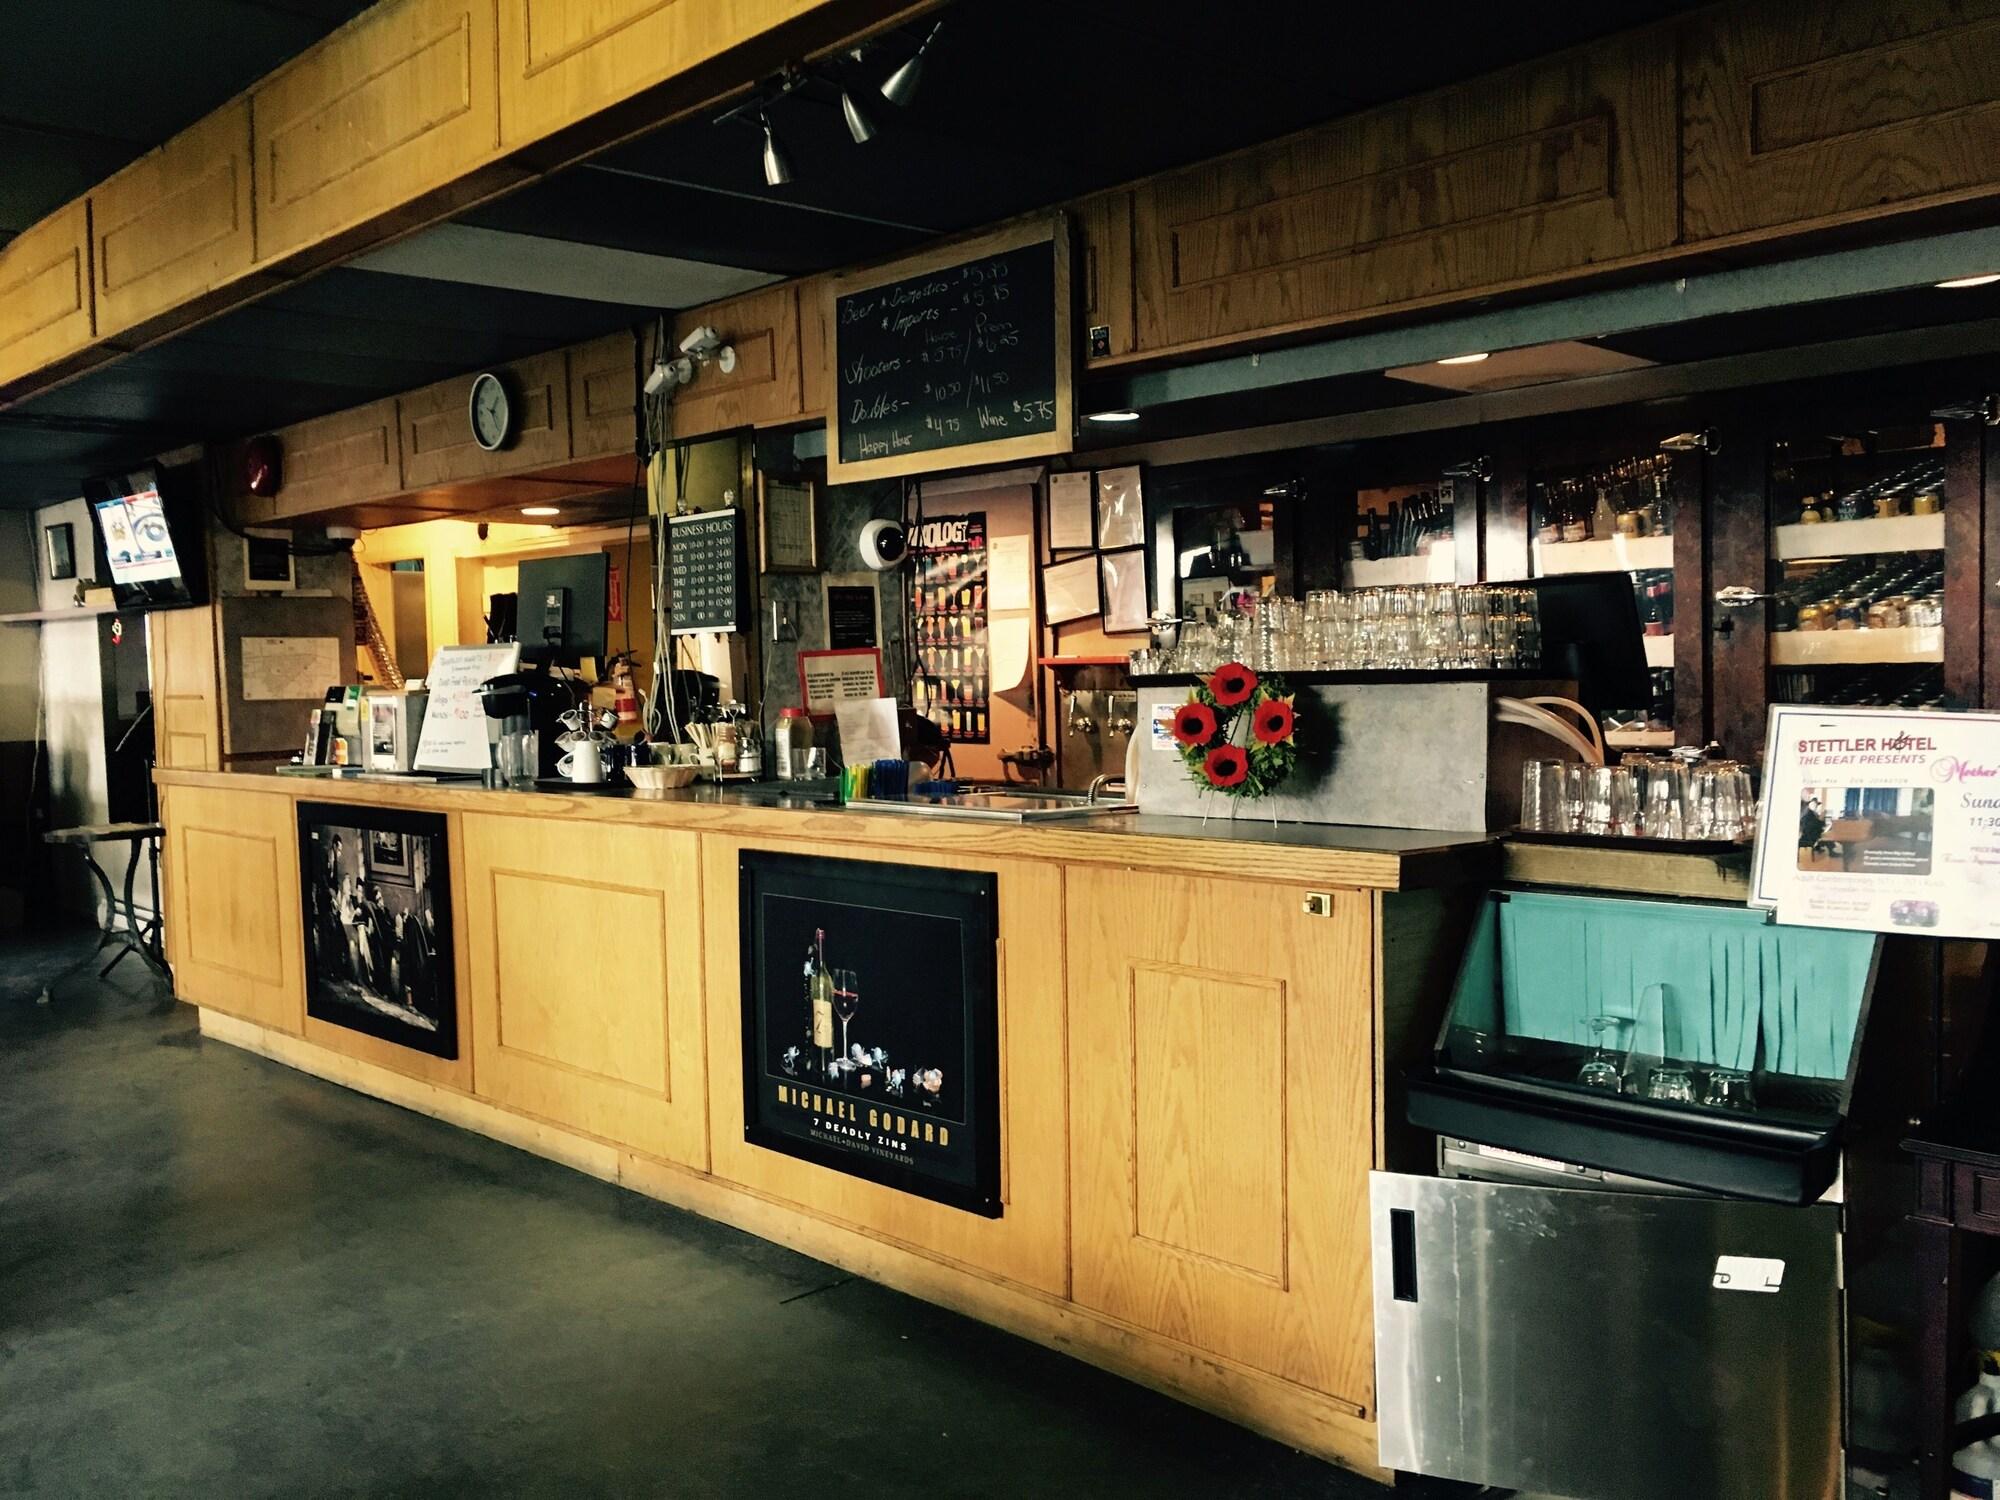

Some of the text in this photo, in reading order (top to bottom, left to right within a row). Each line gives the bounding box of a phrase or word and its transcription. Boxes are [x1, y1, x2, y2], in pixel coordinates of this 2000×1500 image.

[841, 299, 875, 325] Beer
[858, 431, 890, 456] Happy
[892, 429, 913, 448] Hour
[977, 404, 1009, 429] Wine
[671, 519, 733, 538] BUSINESS HOURS
[673, 543, 687, 551] MON
[673, 554, 684, 563] TUE
[673, 566, 687, 575] WED
[673, 578, 686, 587] THU
[673, 590, 682, 599] FRI
[673, 601, 684, 610] SAT
[673, 613, 686, 623] SUN
[1798, 734, 1937, 753] STETTLER HOTEL
[1799, 754, 1927, 765] THE BEAT PRESENTS
[777, 1084, 950, 1147] MICHAEL GODARD
[813, 1117, 907, 1151] 7 DEADLY ZINS
[871, 1146, 915, 1166] VINEYARDS
